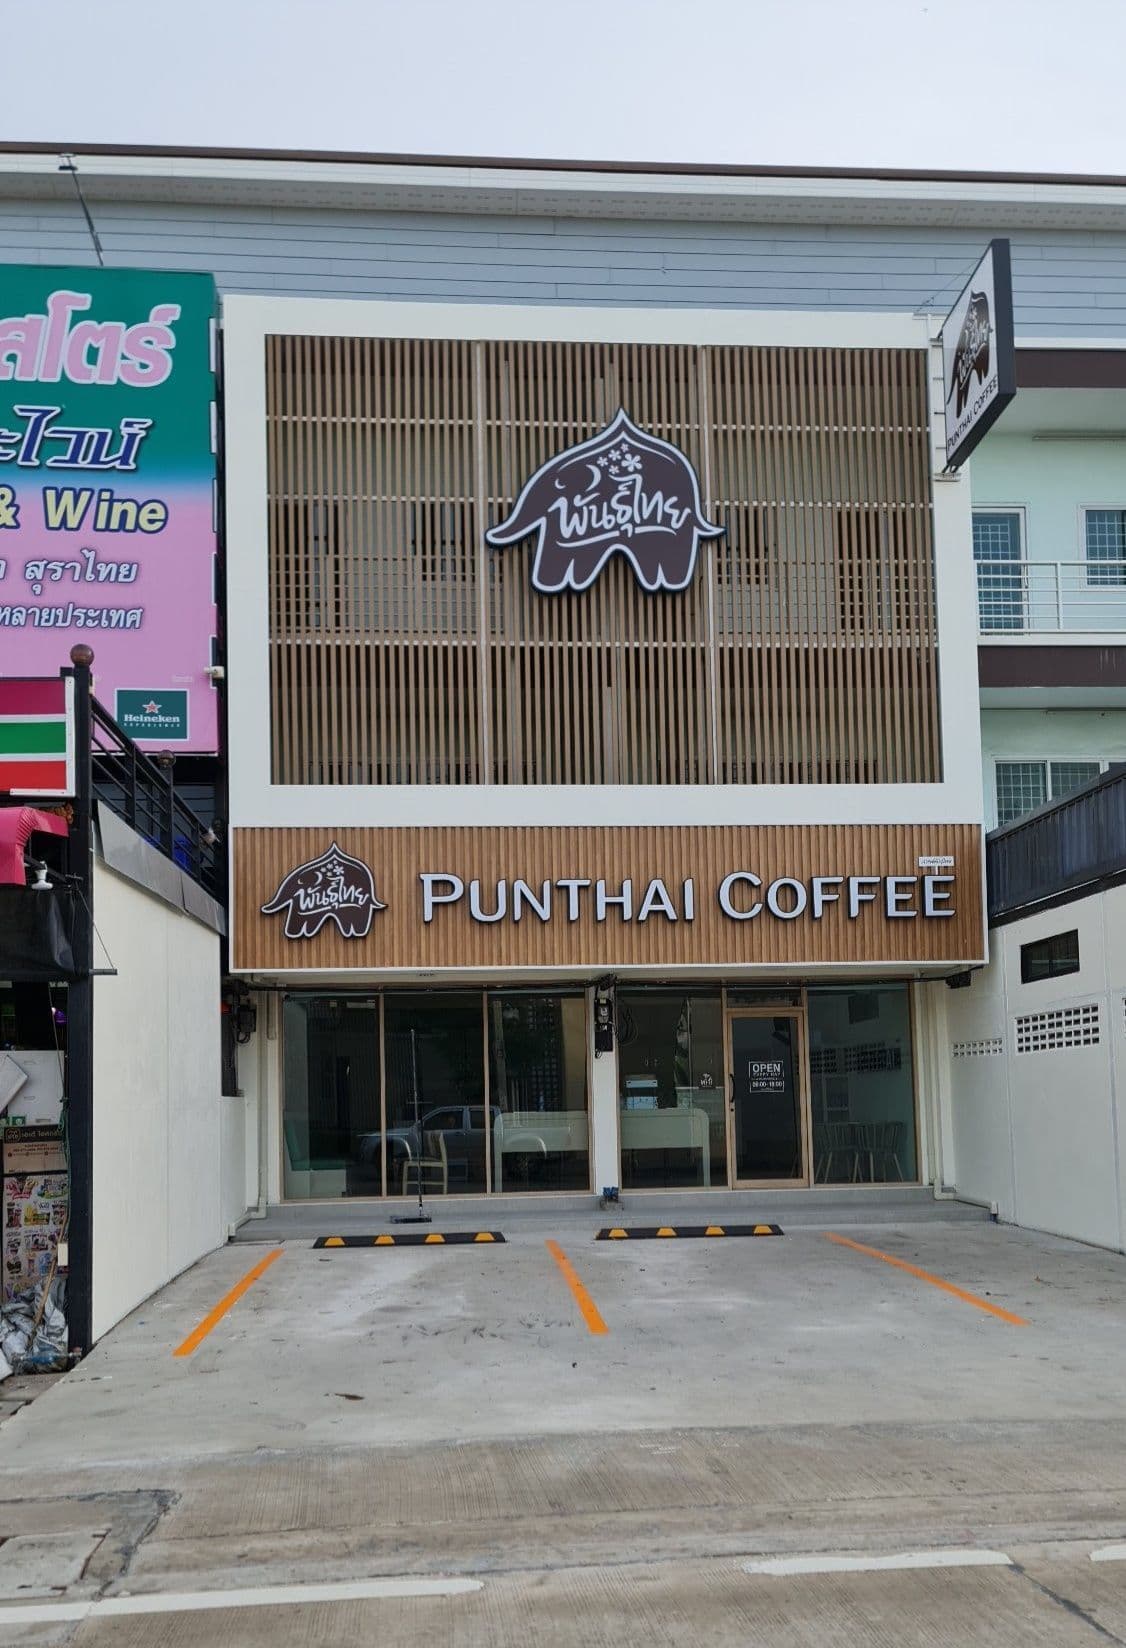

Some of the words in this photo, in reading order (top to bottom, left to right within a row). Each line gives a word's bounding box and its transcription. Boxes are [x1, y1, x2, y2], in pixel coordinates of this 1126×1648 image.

[43, 487, 168, 533] Wine
[25, 548, 138, 595] สุราไทย
[124, 714, 180, 722] Heineken
[419, 872, 695, 923] PUNTHAI
[717, 871, 956, 921] COFFEE
[752, 1063, 781, 1072] OPEN
